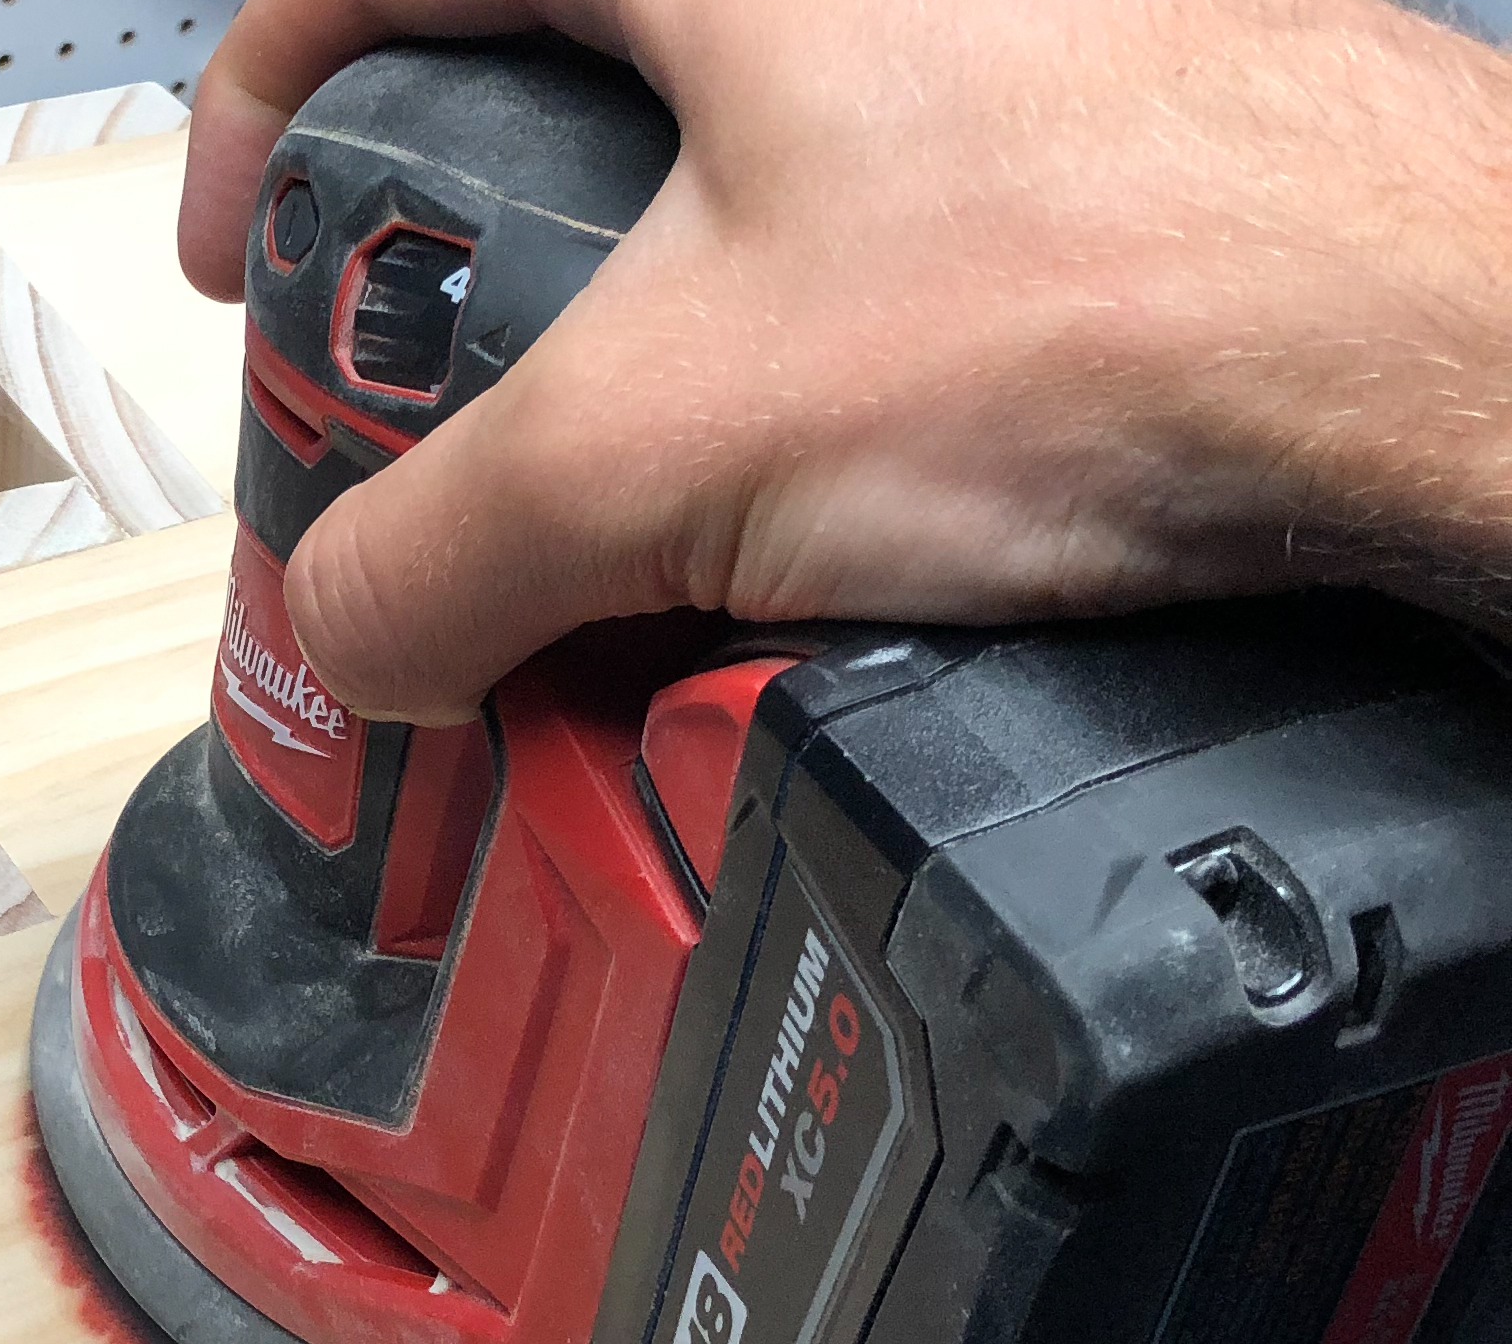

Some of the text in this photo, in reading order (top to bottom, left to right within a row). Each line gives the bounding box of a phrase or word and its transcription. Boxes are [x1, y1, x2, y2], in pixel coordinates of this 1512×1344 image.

[439, 266, 472, 305] 4
[719, 927, 831, 1274] REDLITHIUM
[779, 993, 860, 1224] XC5.0
